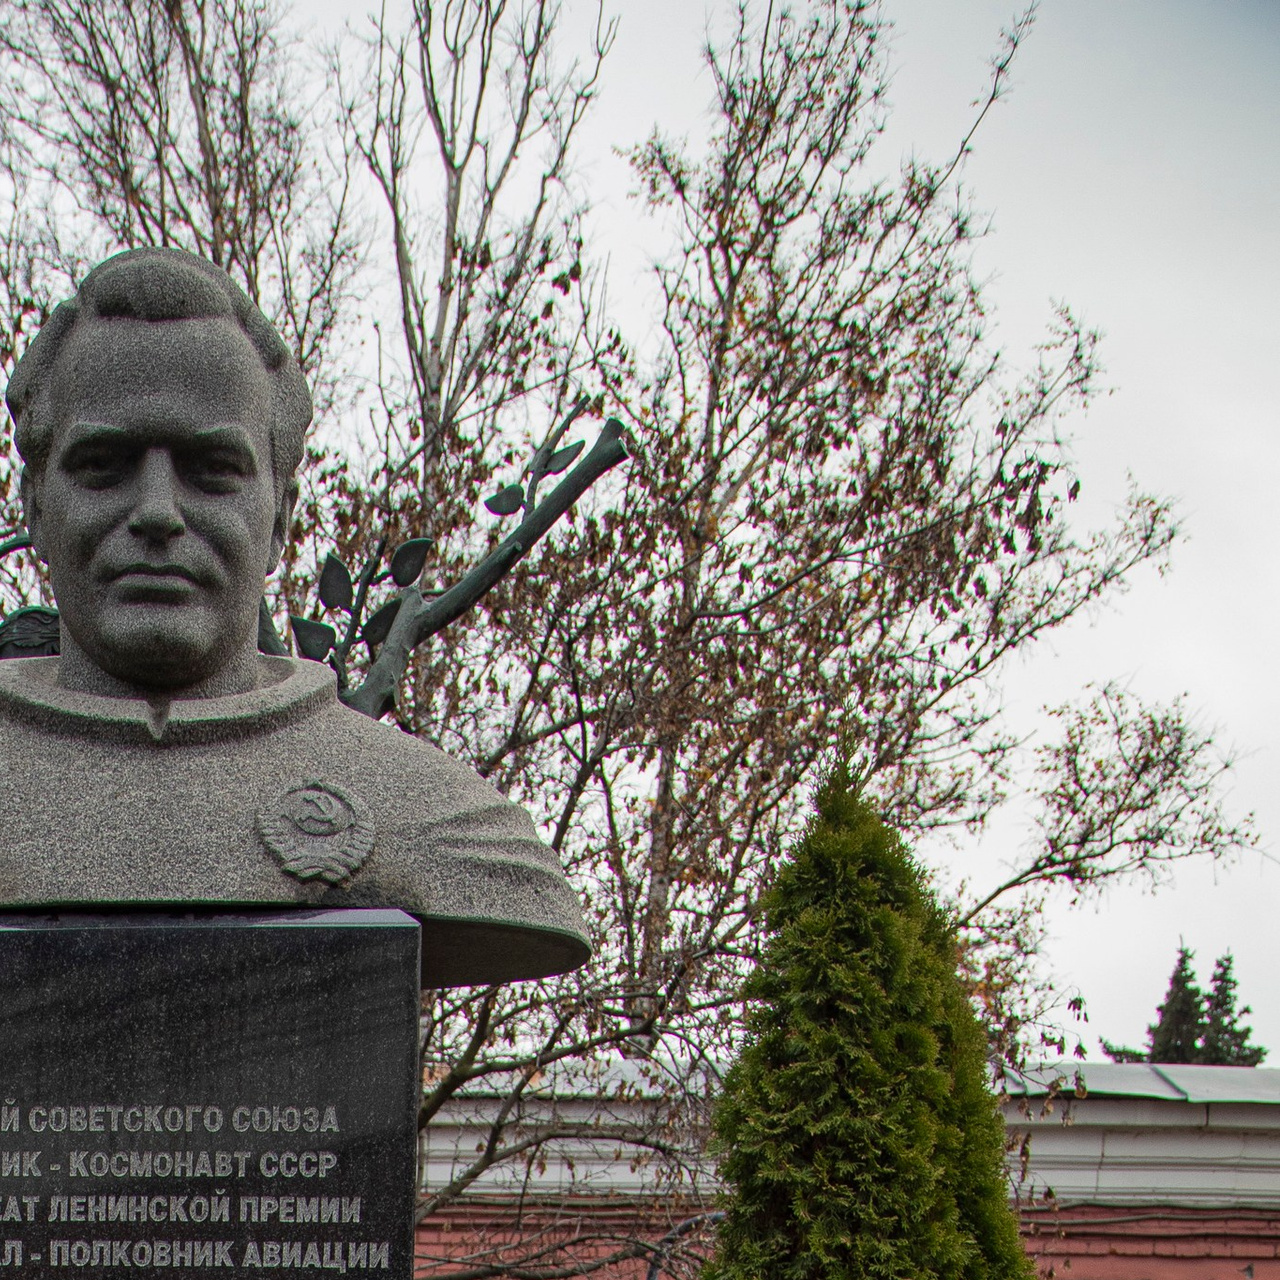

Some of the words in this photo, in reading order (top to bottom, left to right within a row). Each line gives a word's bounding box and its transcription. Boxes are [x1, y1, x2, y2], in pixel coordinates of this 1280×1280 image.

[29, 1105, 223, 1132] СОВЕТСКОГО
[233, 1105, 340, 1133] СОЮЗА
[69, 1151, 251, 1178] КОСМОНАВТ
[260, 1151, 338, 1178] СССР
[48, 1189, 230, 1222] ЛЕНИНСКОЙ
[240, 1197, 362, 1223] ПРЕМИИ
[50, 1240, 233, 1268] ПОЛКОВНИК
[242, 1241, 390, 1274] АВИАЦИИ
